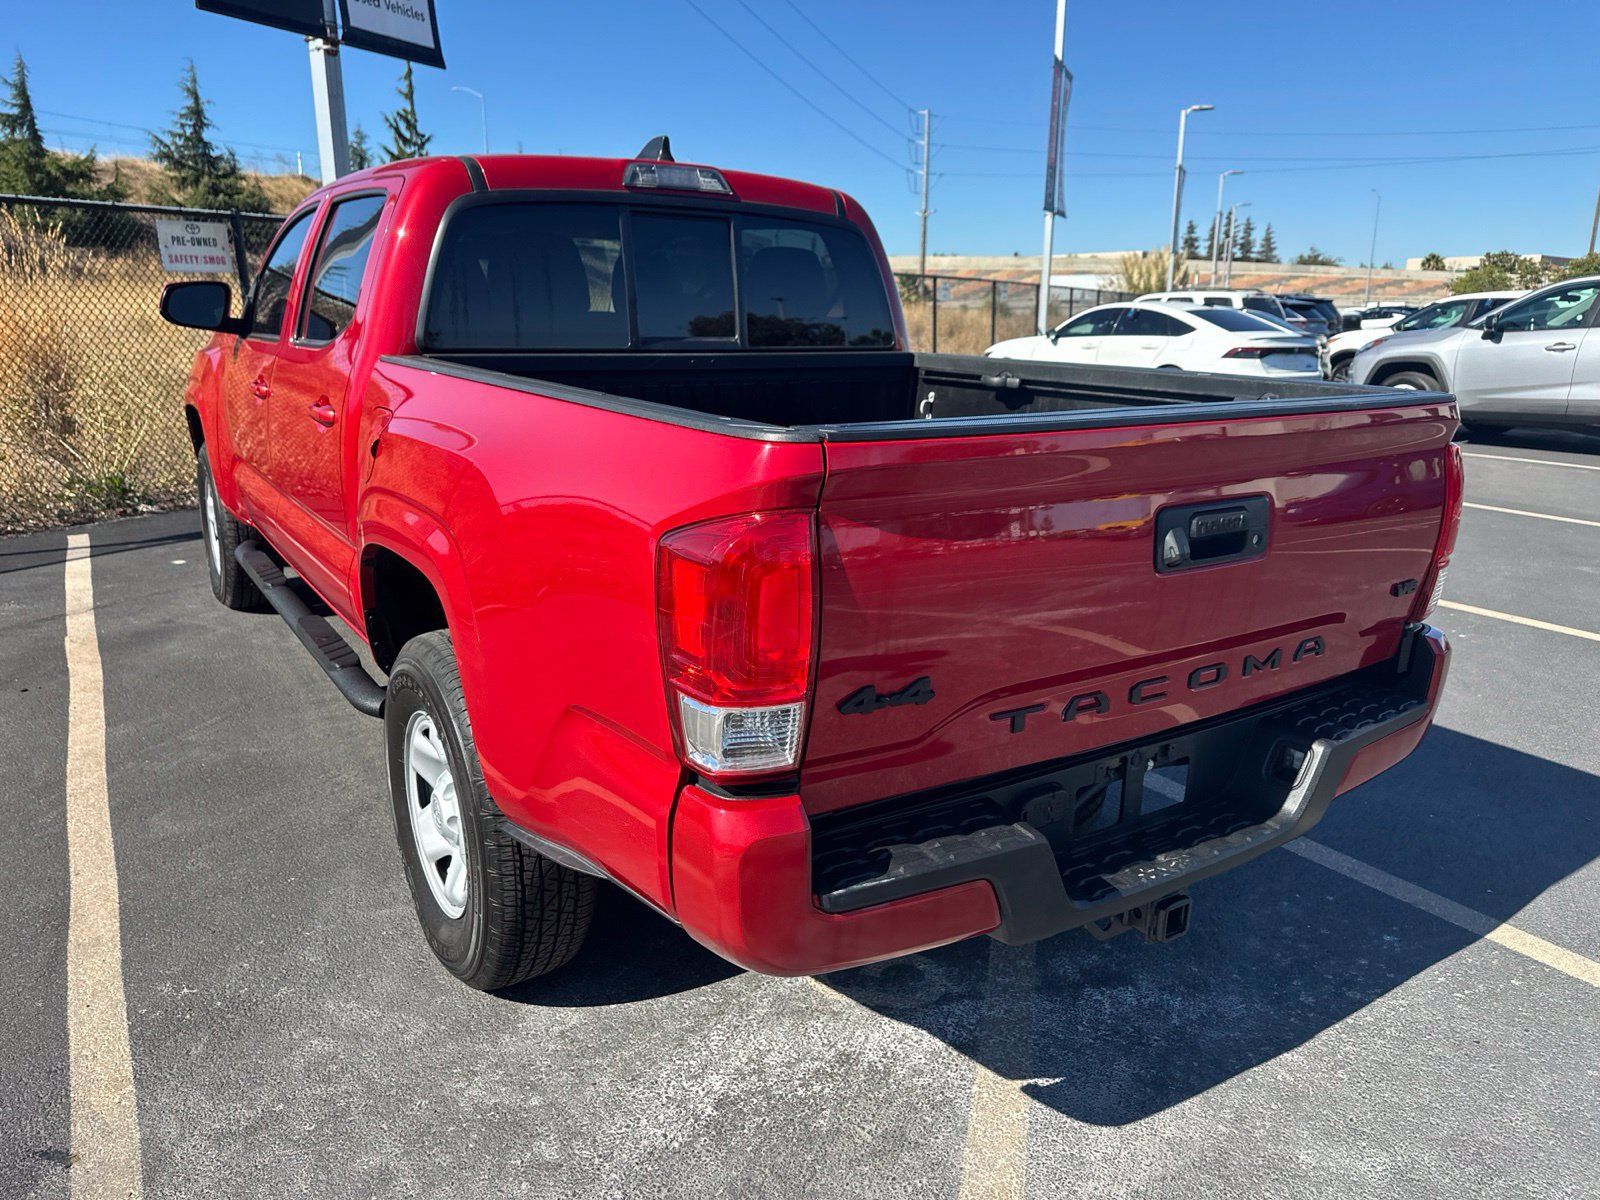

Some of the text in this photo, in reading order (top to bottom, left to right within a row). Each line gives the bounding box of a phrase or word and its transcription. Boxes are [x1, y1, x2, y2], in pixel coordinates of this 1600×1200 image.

[384, 0, 426, 22] Vehicles
[171, 235, 218, 248] PRE-OWNED
[835, 676, 935, 715] 4x4
[989, 635, 1326, 734] TACOMA
